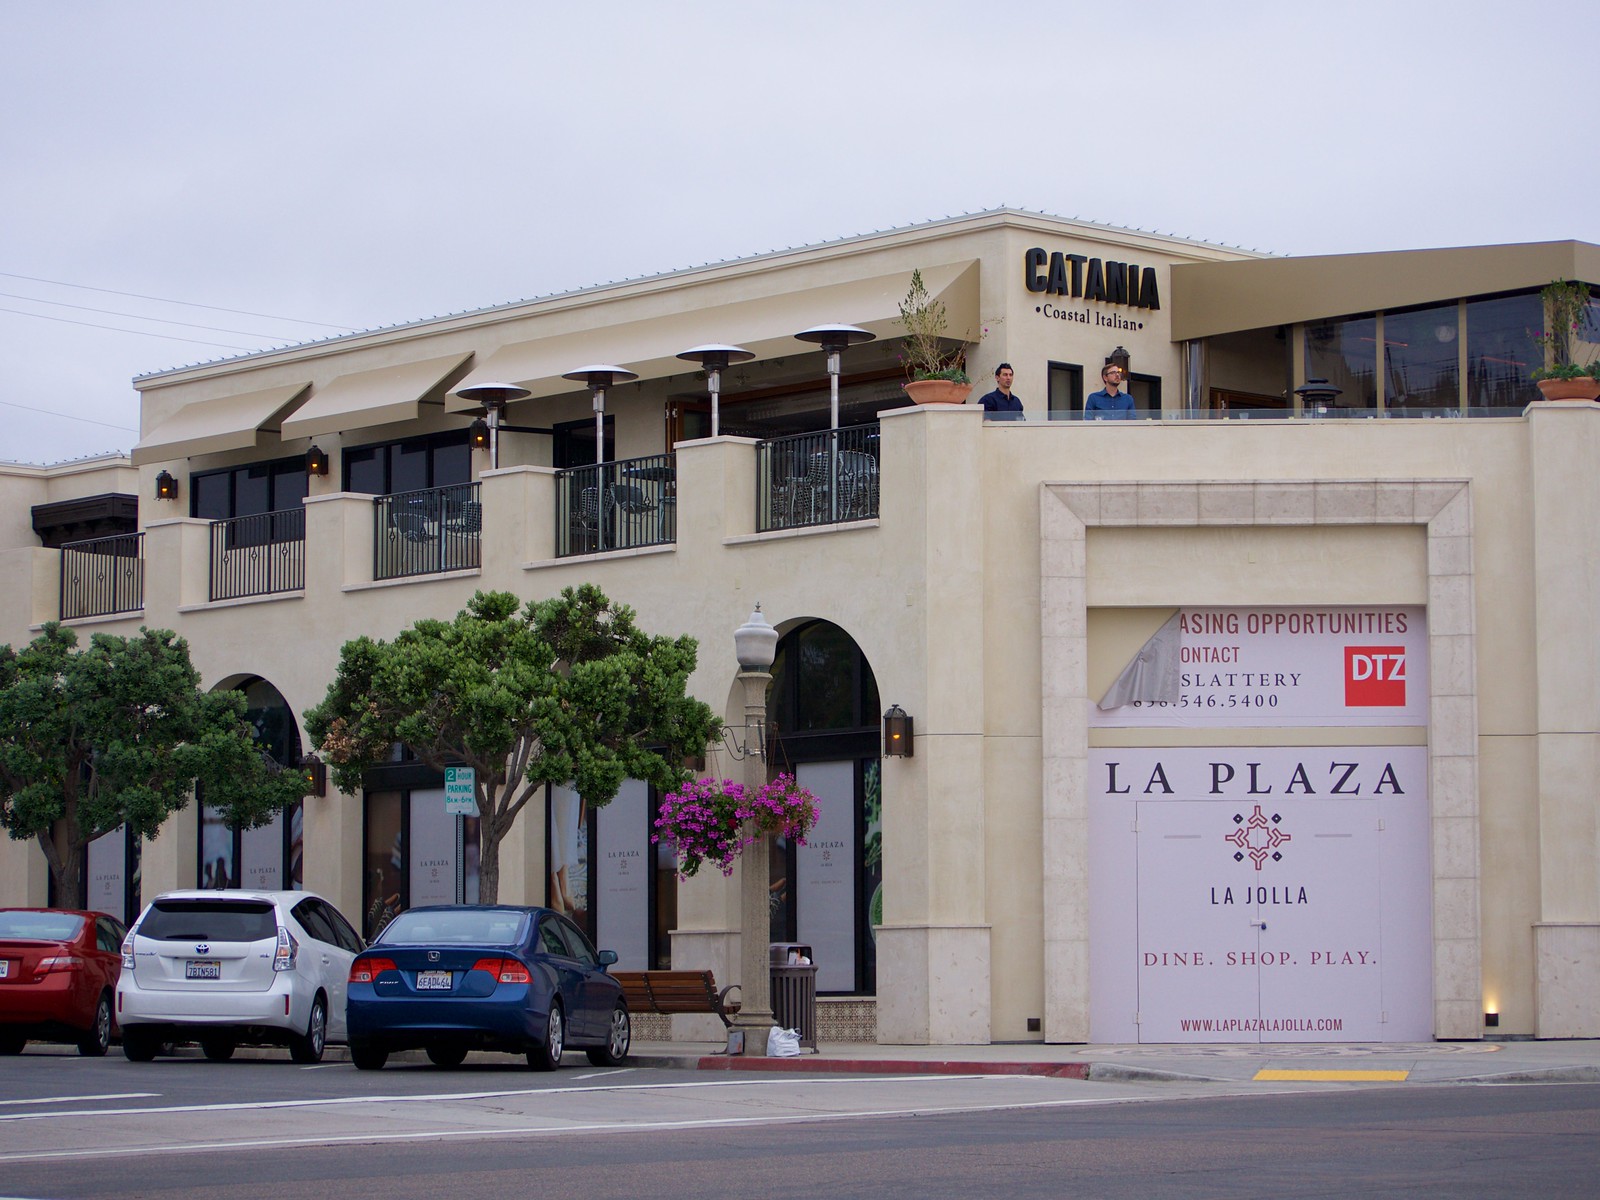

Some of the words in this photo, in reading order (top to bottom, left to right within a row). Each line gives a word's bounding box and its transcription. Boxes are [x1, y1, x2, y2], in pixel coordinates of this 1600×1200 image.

[1026, 247, 1160, 310] CATANIA
[1044, 304, 1090, 324] Coastal
[1096, 312, 1137, 331] Italian
[1248, 612, 1408, 634] OPPORTUNITIES
[1353, 654, 1406, 681] DTZ
[1181, 673, 1302, 687] SLATTERY
[448, 770, 454, 780] 2
[1105, 762, 1175, 794] LA
[1209, 761, 1405, 796] PLAZA
[448, 785, 472, 793] PARKING
[618, 850, 640, 858] PLAZA
[430, 859, 449, 867] PLAZA
[1211, 886, 1234, 905] LA
[1246, 886, 1308, 905] JOLLA
[1144, 952, 1213, 966] DINE.
[1227, 952, 1297, 966] SHOP.
[1310, 951, 1377, 965] PLAY.
[1180, 1018, 1343, 1032] WWW.LAPLAZALAJOLLA.COM
